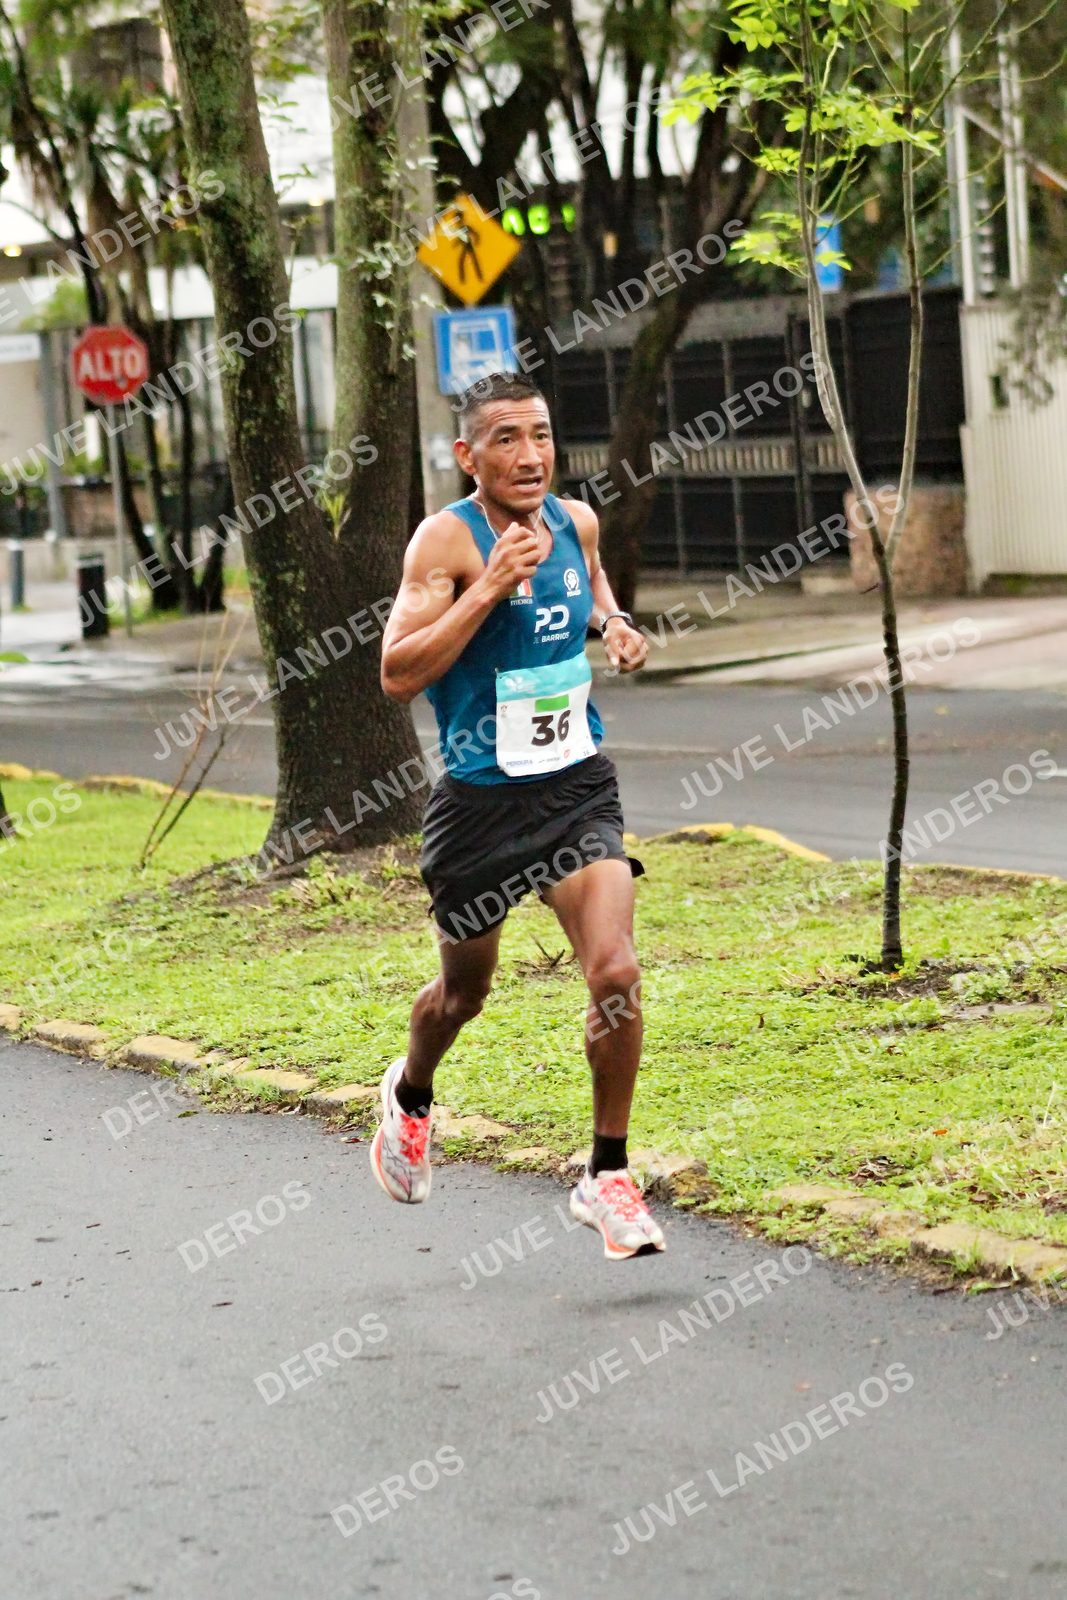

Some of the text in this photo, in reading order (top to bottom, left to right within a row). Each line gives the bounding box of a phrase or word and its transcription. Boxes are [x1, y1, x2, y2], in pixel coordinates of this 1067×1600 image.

[79, 347, 143, 381] ALTO
[534, 604, 570, 633] PD
[541, 632, 570, 642] BARRIOS
[531, 710, 571, 746] 36
